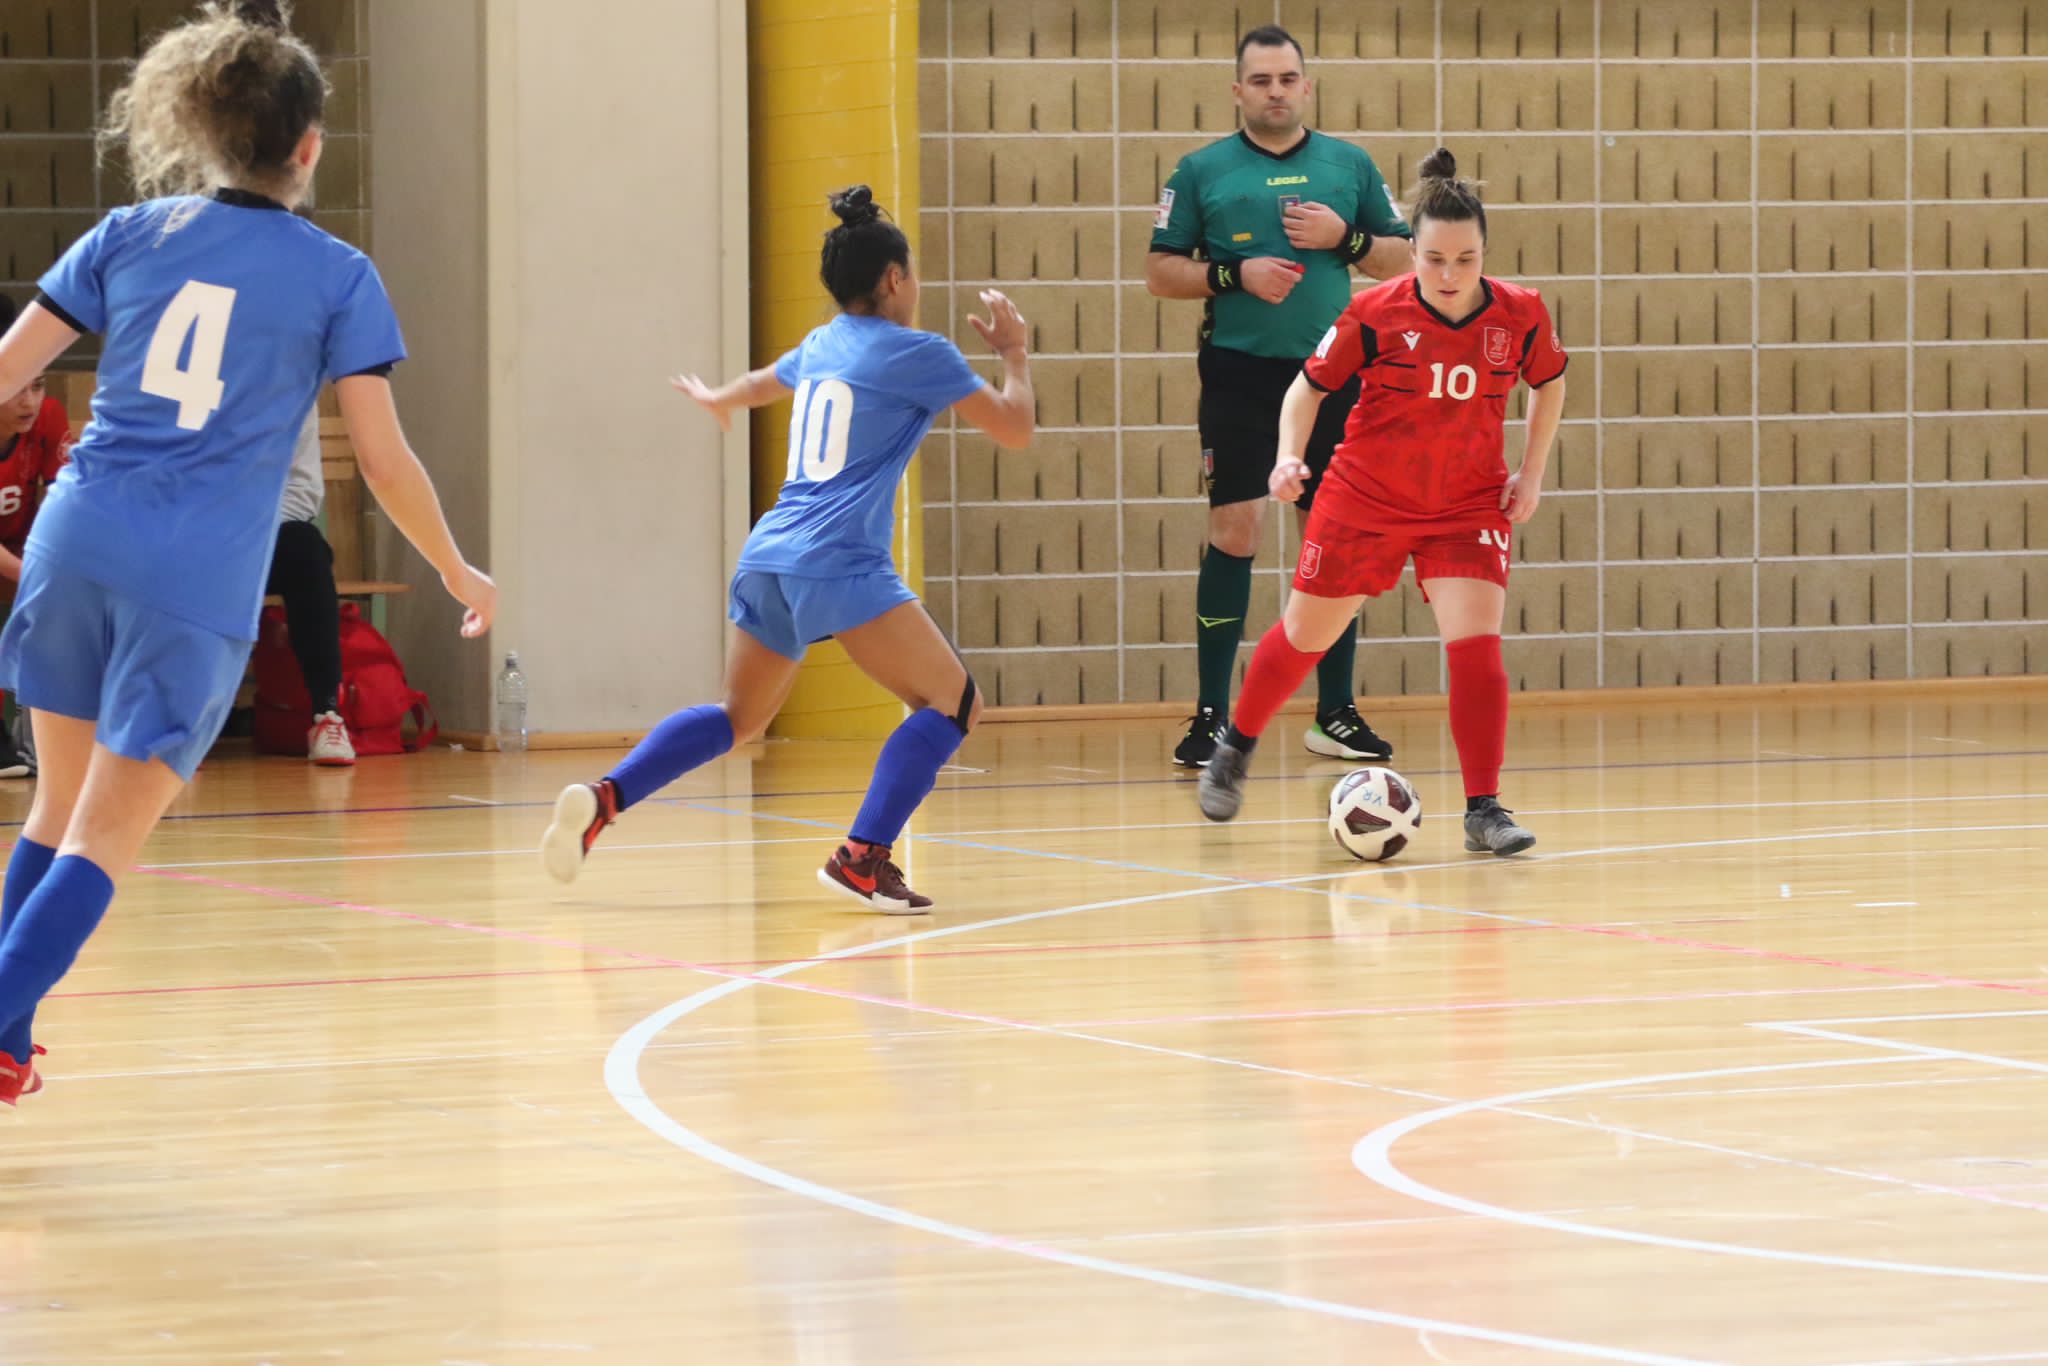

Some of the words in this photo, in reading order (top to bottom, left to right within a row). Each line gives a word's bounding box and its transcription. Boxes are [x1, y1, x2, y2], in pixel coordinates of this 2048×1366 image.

[140, 279, 237, 431] 4
[1428, 362, 1477, 401] 10
[785, 378, 854, 482] 10
